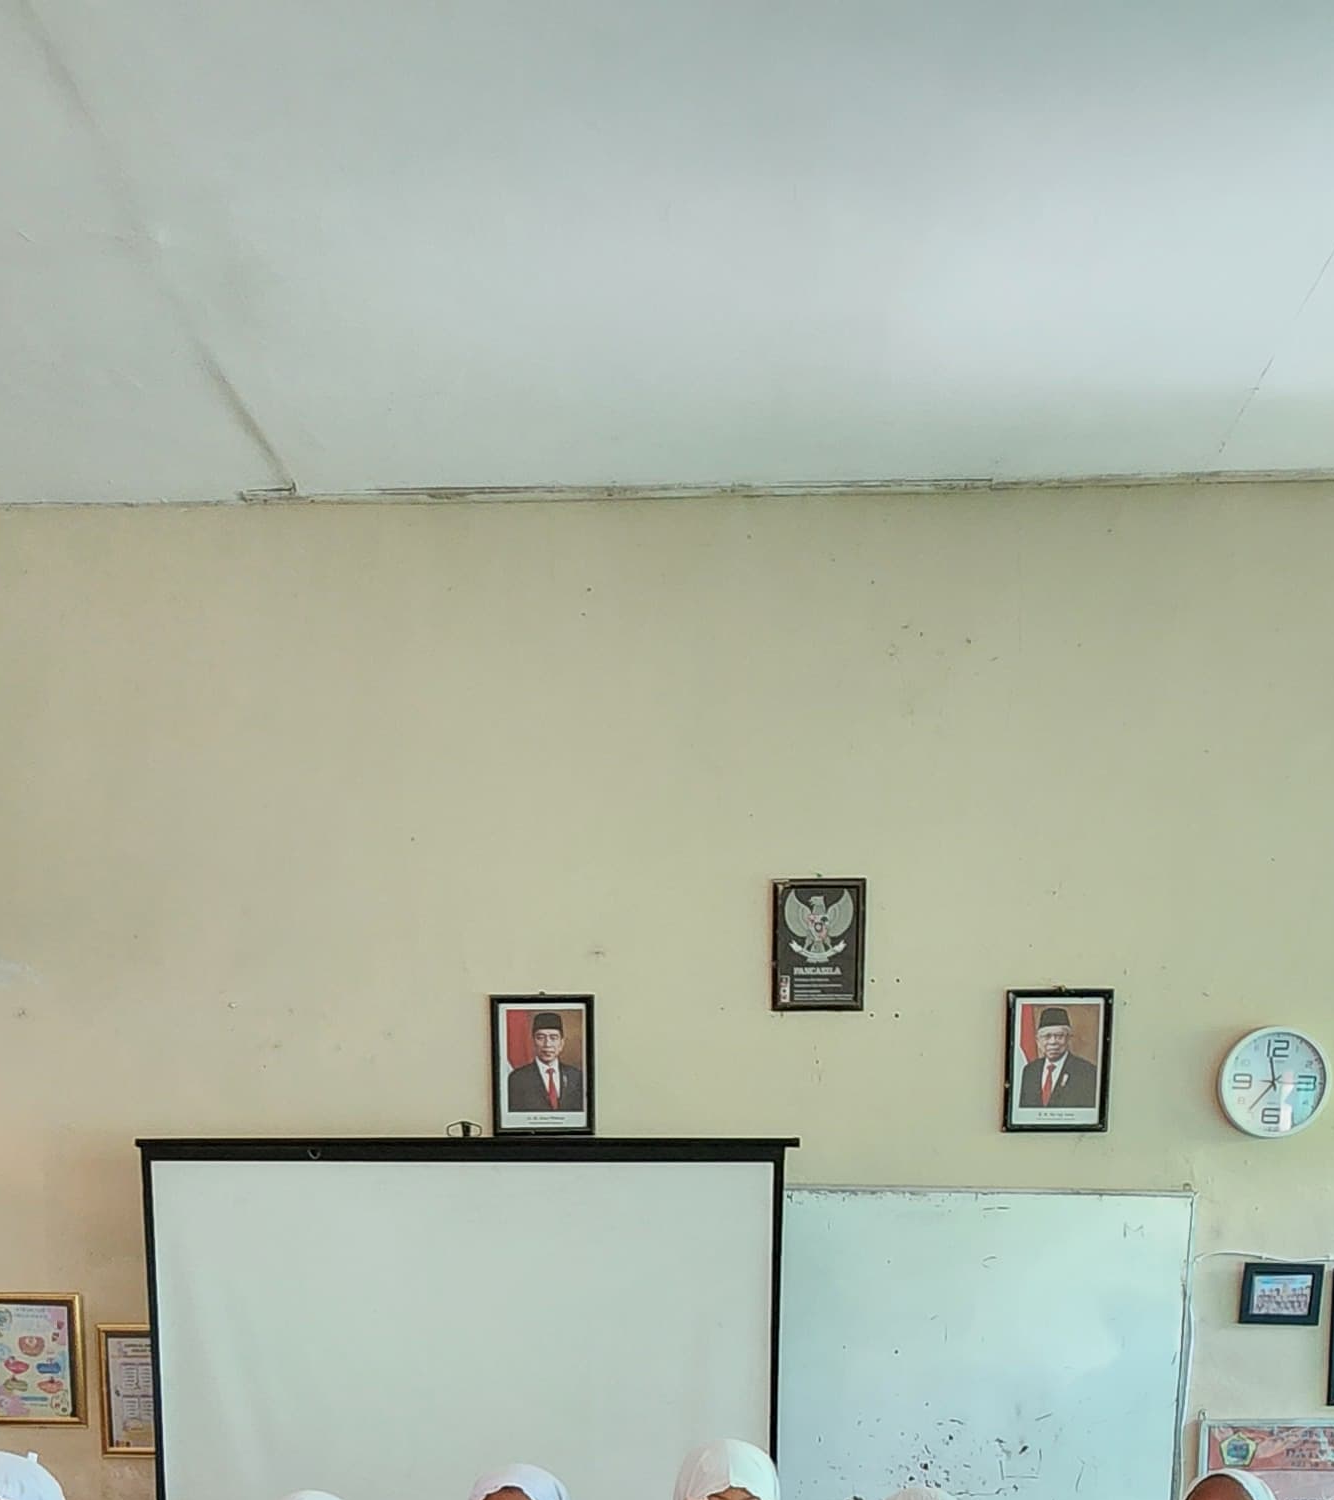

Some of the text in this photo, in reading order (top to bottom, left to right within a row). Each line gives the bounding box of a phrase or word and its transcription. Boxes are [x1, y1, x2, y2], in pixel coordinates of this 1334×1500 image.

[1267, 1039, 1289, 1058] 12
[1232, 1073, 1253, 1090] 9
[1296, 1074, 1317, 1092] 3
[1261, 1107, 1280, 1124] 6
